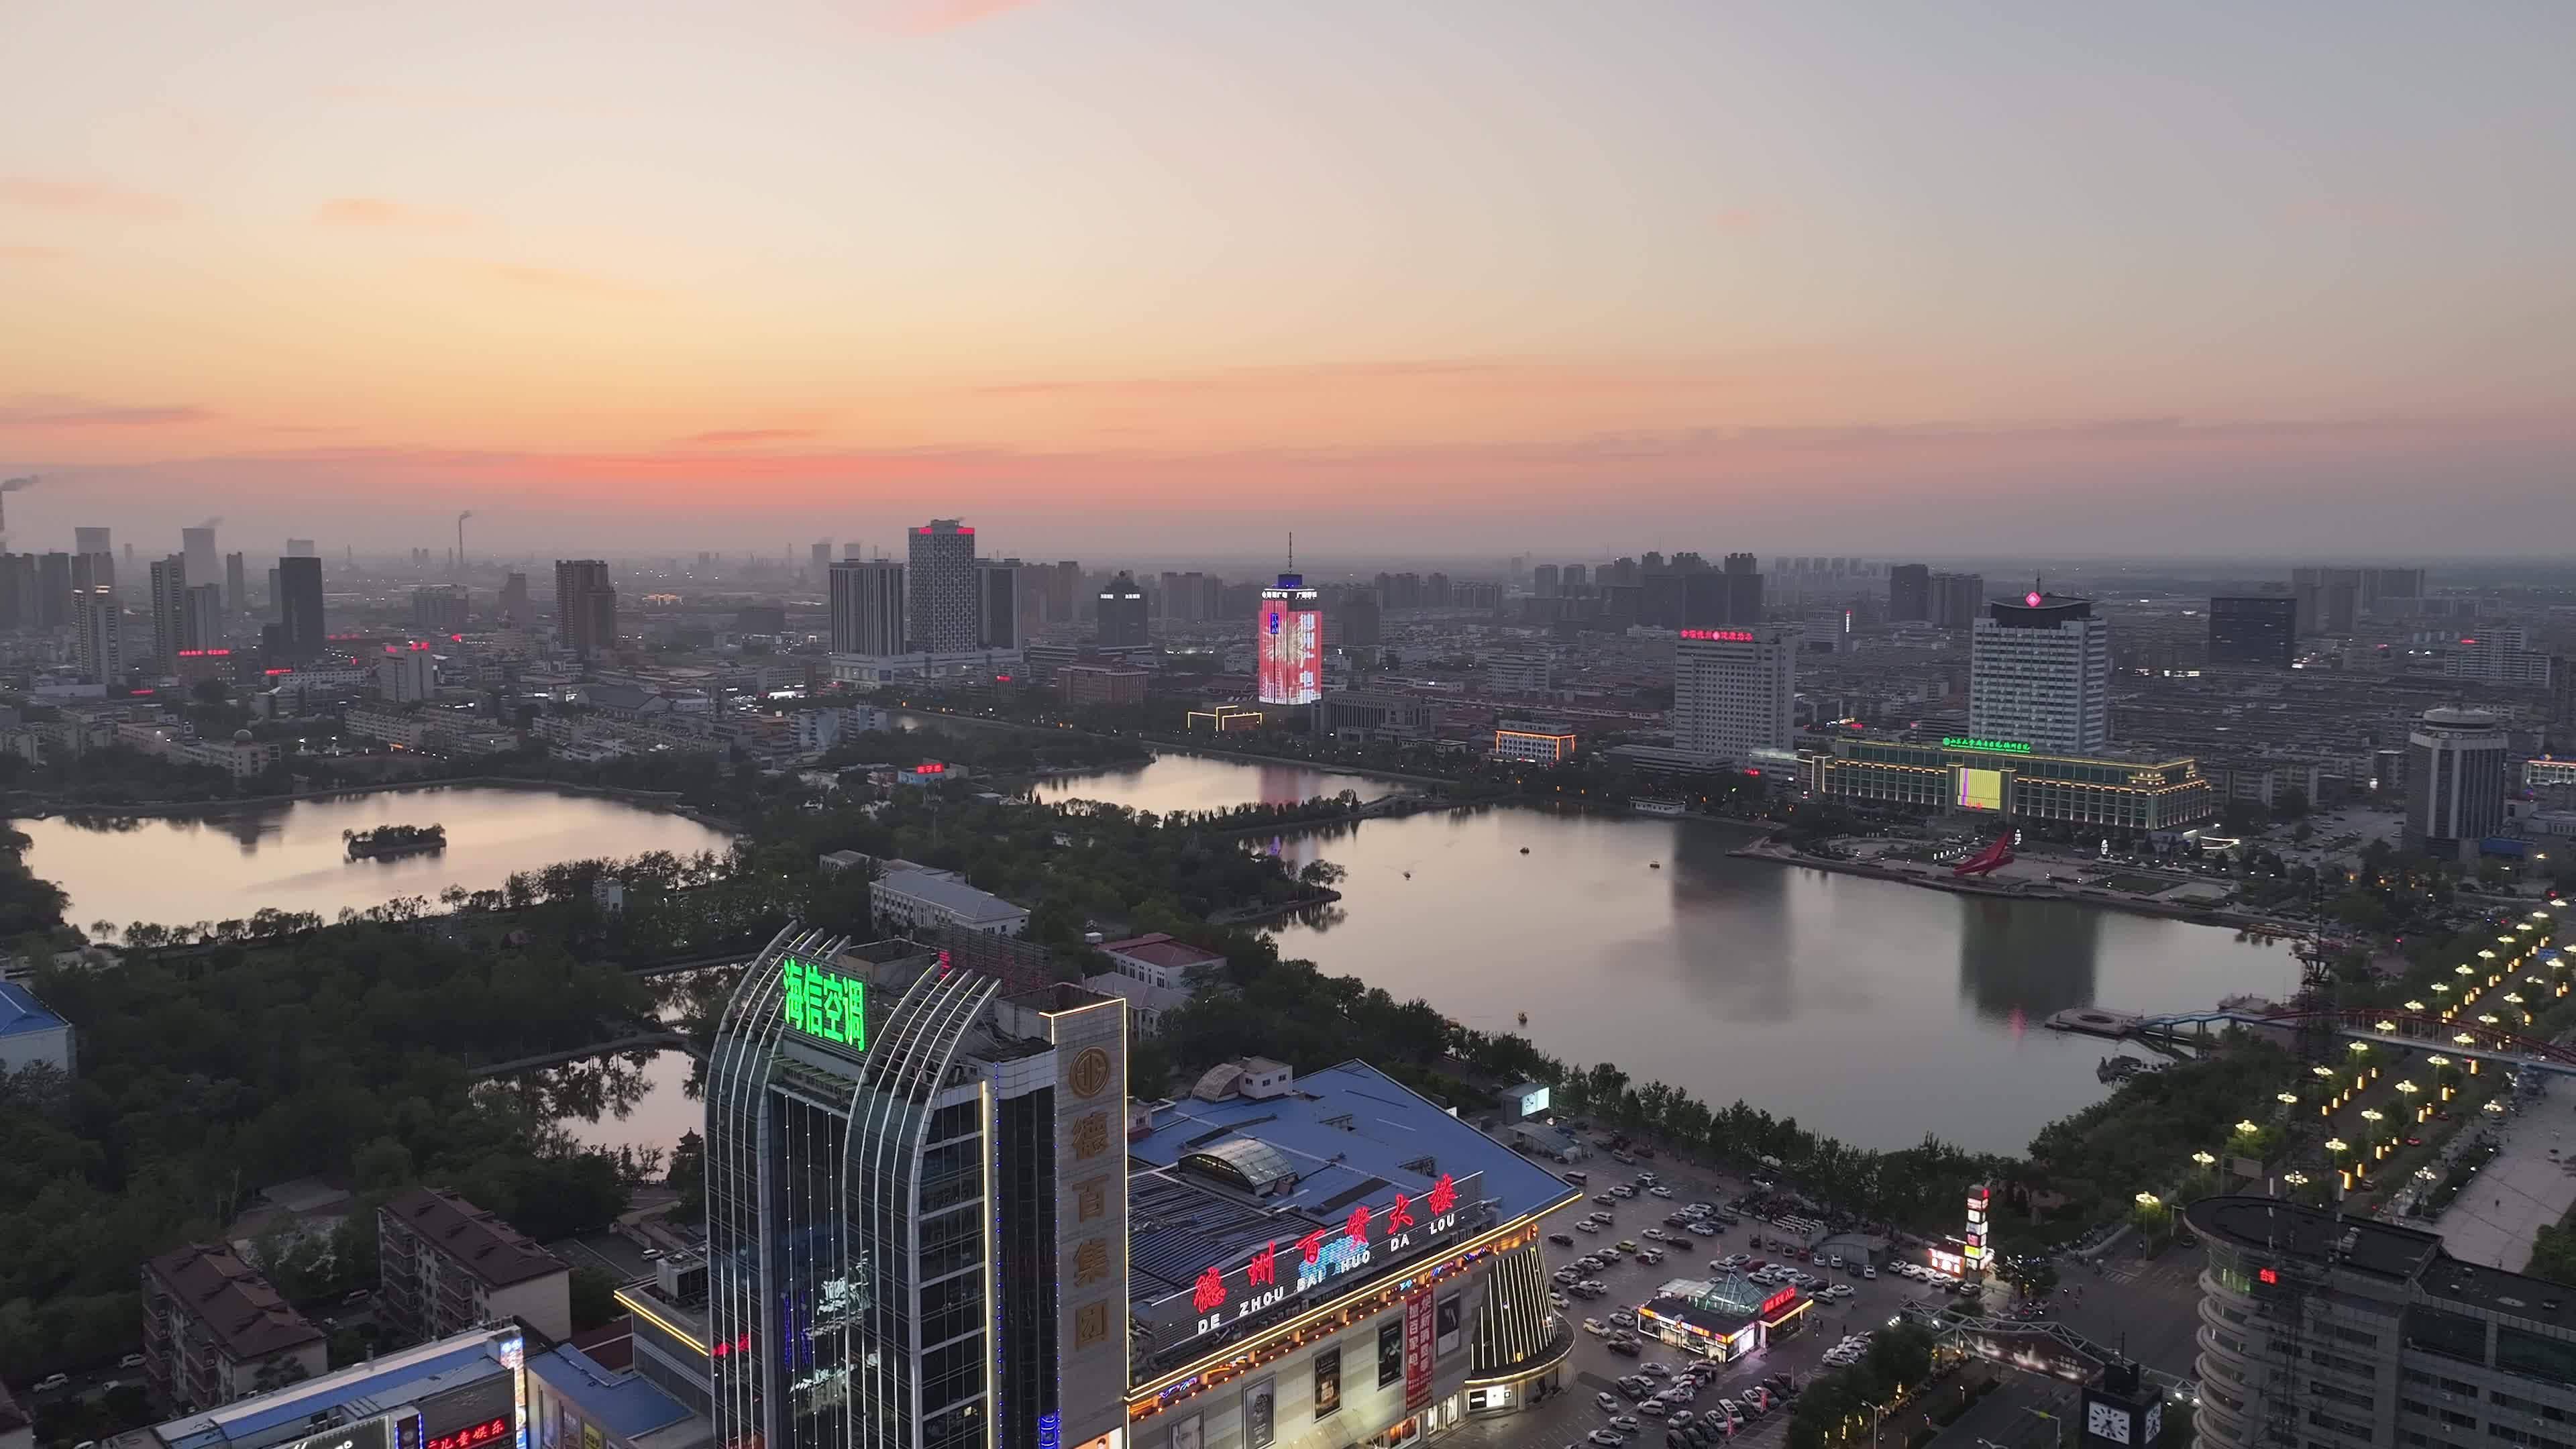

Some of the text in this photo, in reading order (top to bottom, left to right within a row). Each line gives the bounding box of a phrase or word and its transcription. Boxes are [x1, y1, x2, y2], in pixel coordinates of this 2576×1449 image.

[784, 956, 865, 1052] 海信空调
[1071, 1110, 1111, 1352] 德百集团
[1193, 1174, 1456, 1314] 德州百货大楼
[1197, 1213, 1455, 1335] DE ZHOU BAI HUO DA LOU
